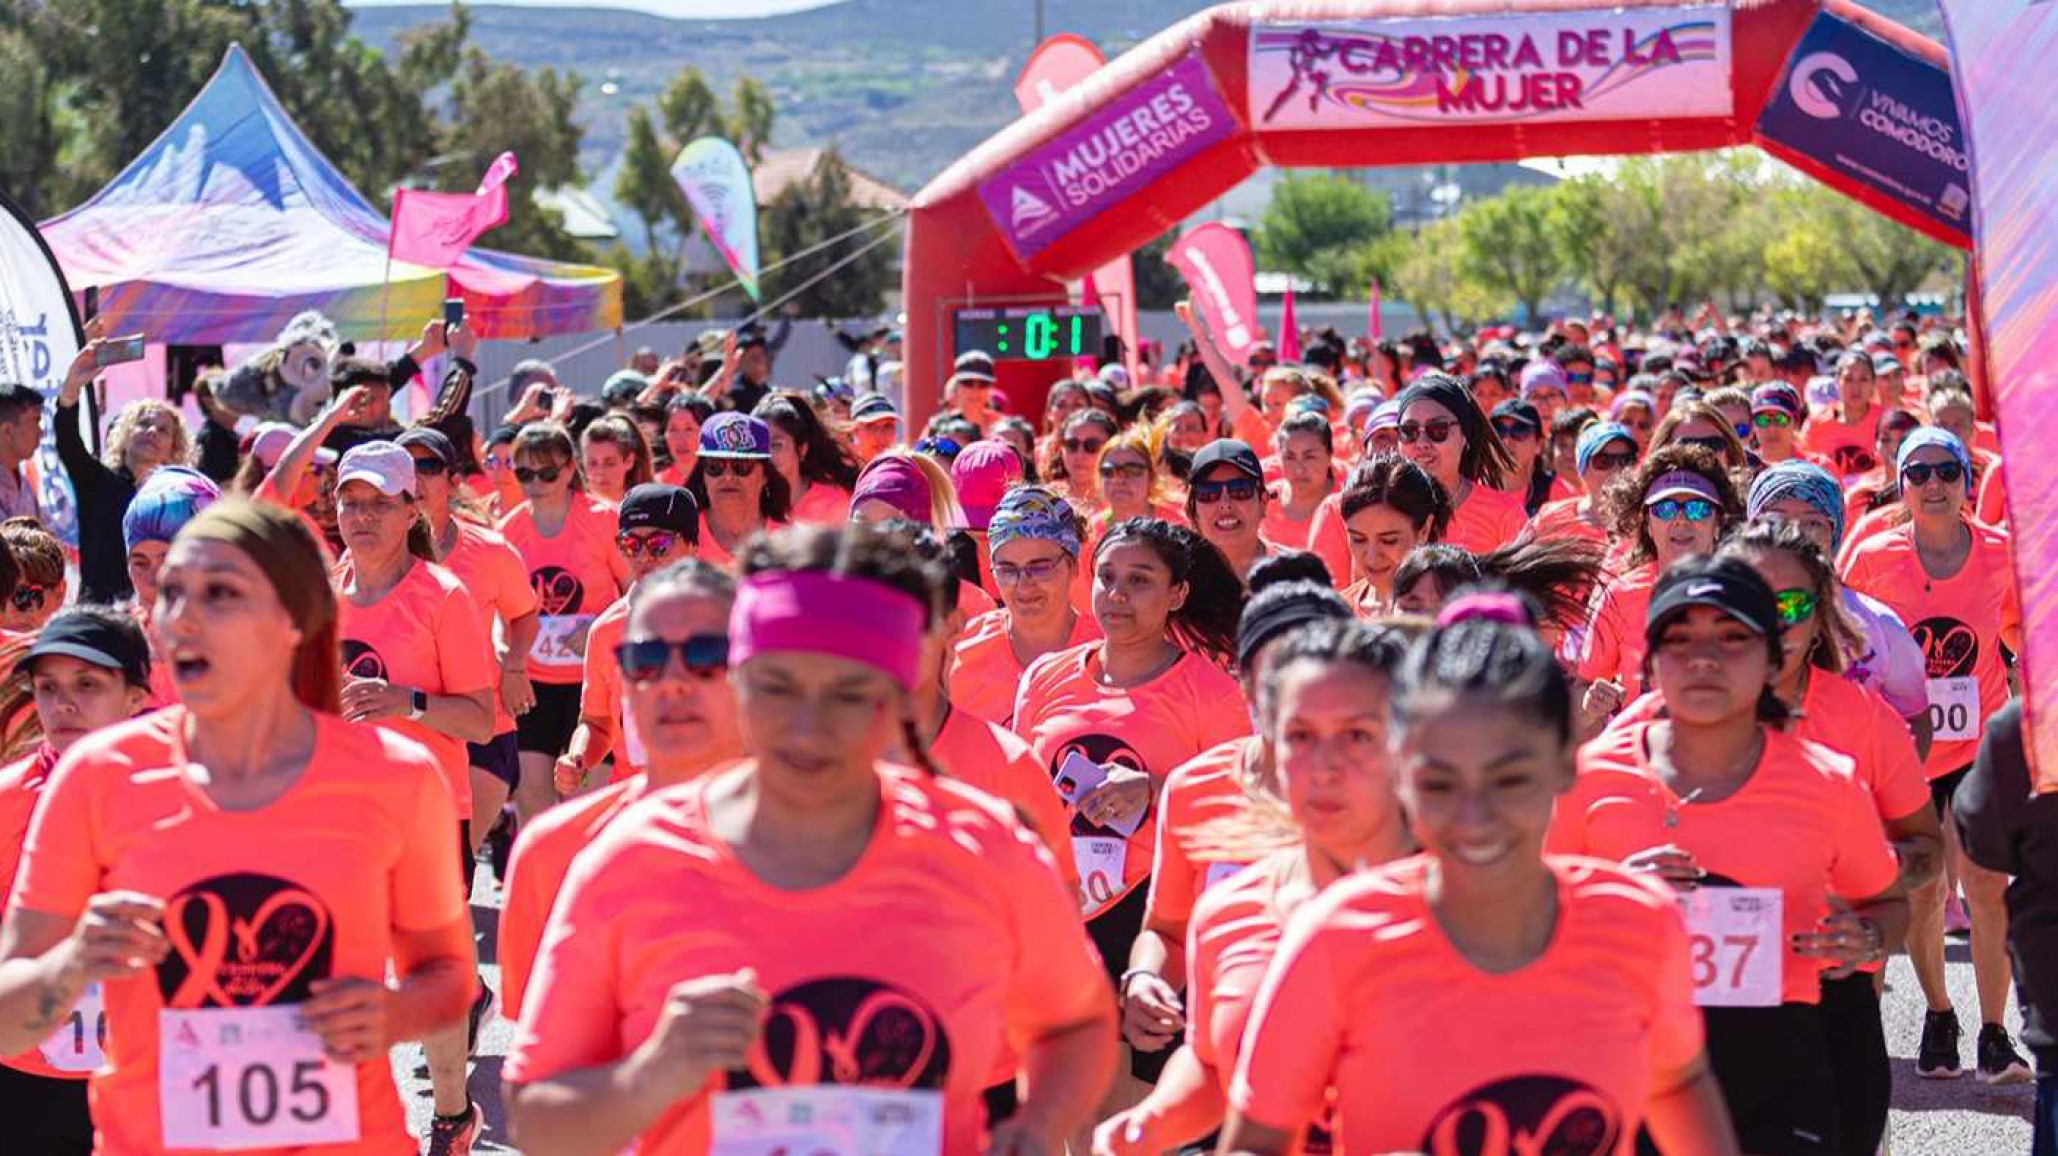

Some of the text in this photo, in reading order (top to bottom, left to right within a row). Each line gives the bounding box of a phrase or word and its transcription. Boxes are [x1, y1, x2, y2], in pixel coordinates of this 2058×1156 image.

[1337, 27, 1682, 74] CARRERA DE LA
[1434, 72, 1585, 113] MUJER
[1871, 88, 1953, 143] VIVAMOS
[1053, 84, 1194, 187] MUJERES
[1065, 107, 1213, 207] SOLIDARIAS
[1859, 108, 1969, 171] COMODORO
[191, 1060, 331, 1128] 105
